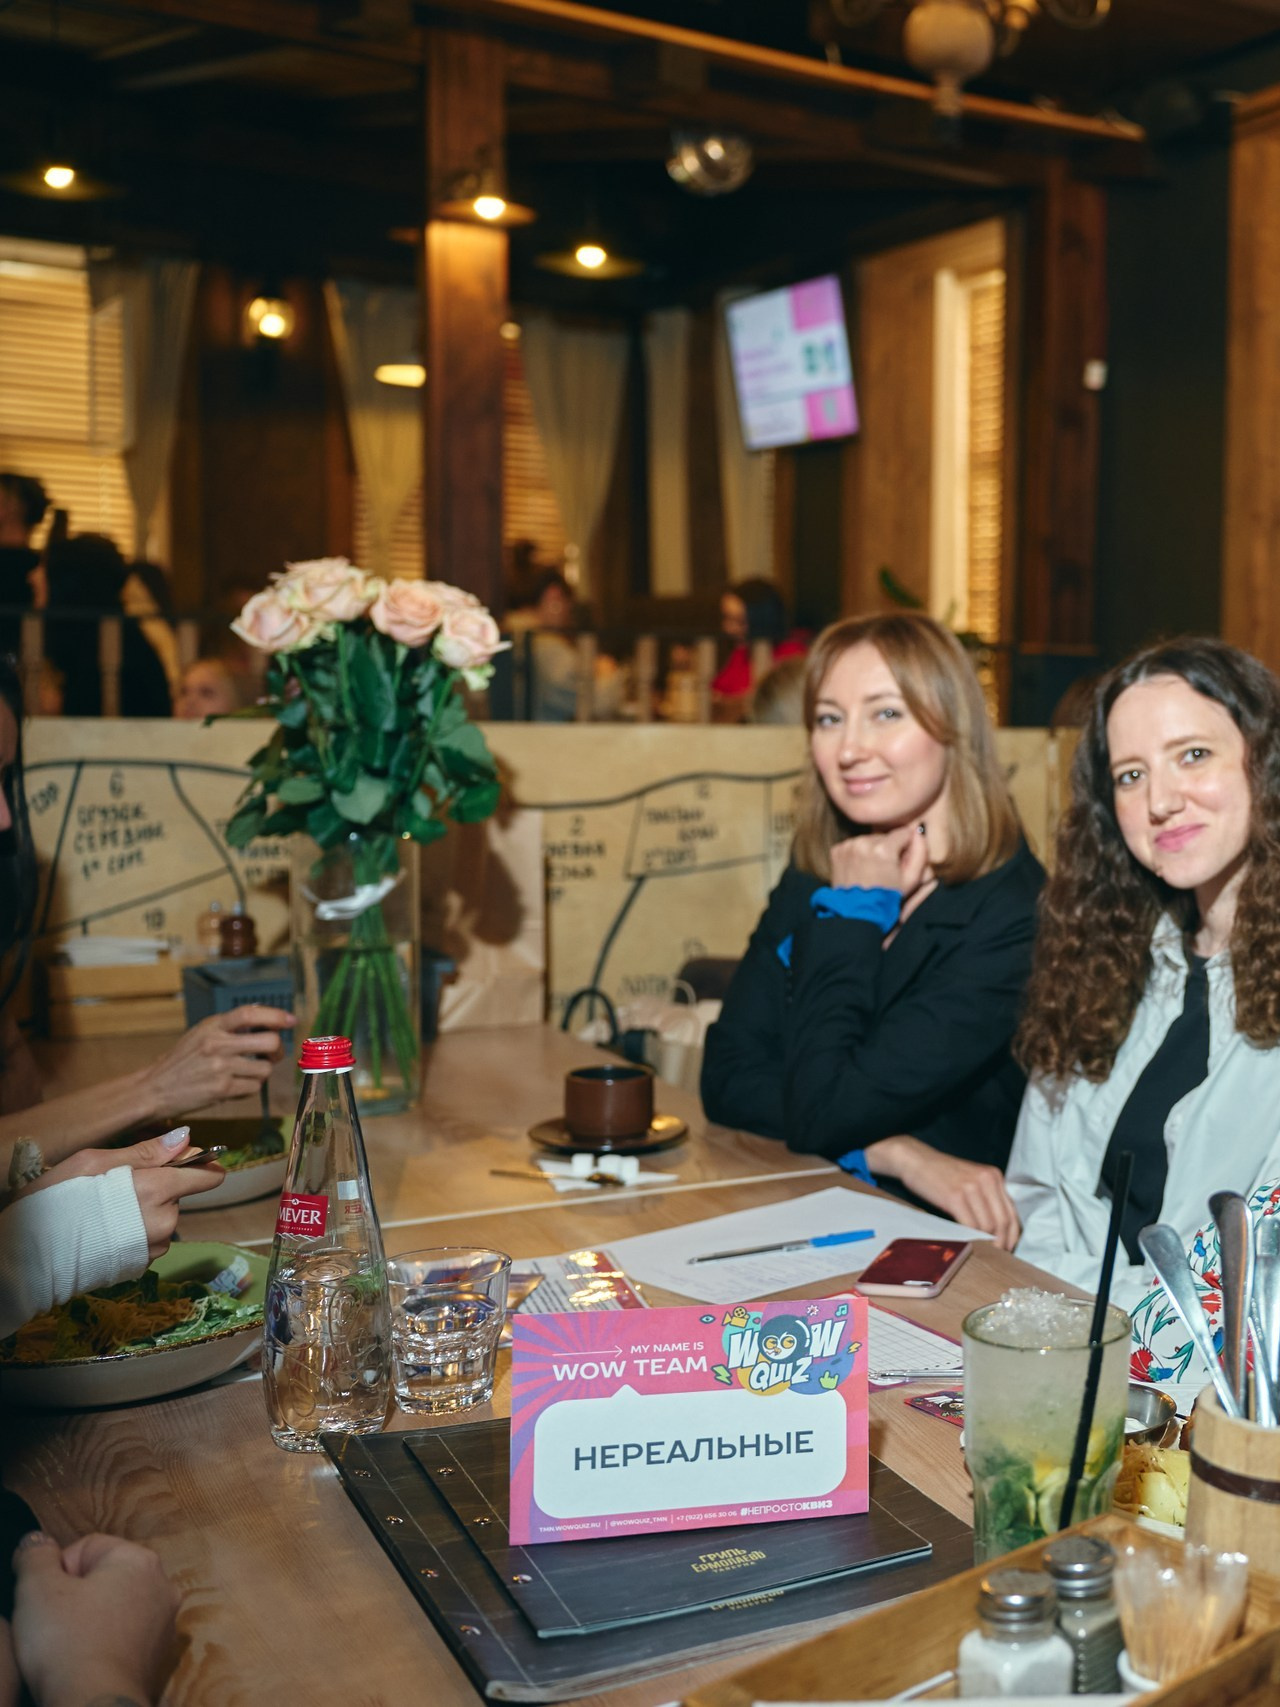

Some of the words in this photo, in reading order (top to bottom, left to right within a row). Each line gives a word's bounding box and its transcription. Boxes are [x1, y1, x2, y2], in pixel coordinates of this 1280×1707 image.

[630, 1345, 650, 1354] MY
[653, 1342, 690, 1352] NAME
[693, 1341, 704, 1350] IS
[552, 1360, 627, 1381] WOW
[633, 1355, 708, 1376] TEAM
[749, 1356, 813, 1391] QUIZ
[573, 1430, 815, 1472] НЕРЕАЛЬНЫЕ
[740, 1499, 833, 1517] #НЕПРОСТОКВИЗ
[609, 1516, 668, 1527] @WOWQUIZ_TMN
